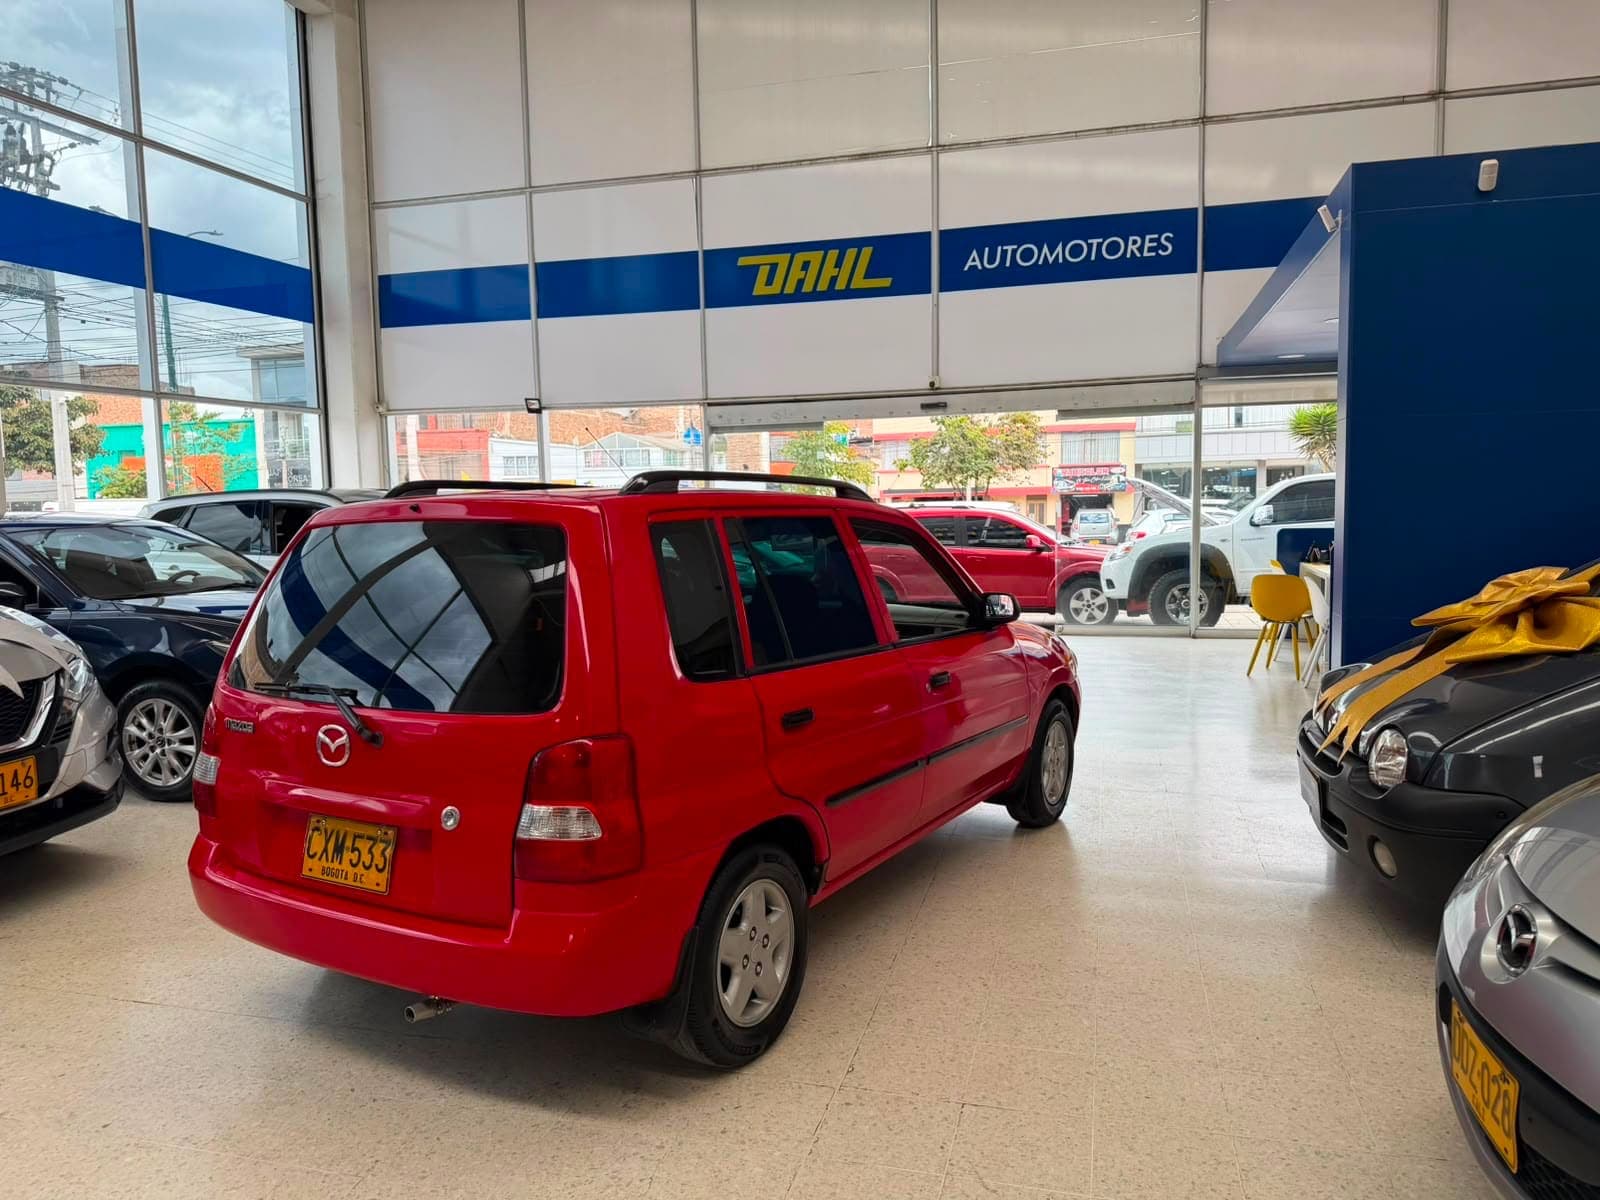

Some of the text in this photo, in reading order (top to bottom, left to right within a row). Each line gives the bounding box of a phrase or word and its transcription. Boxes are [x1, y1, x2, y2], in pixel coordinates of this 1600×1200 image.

[737, 232, 1174, 295] DAHL AUTOMOTORES
[0, 765, 34, 796] 146
[321, 866, 348, 881] BOGOTA
